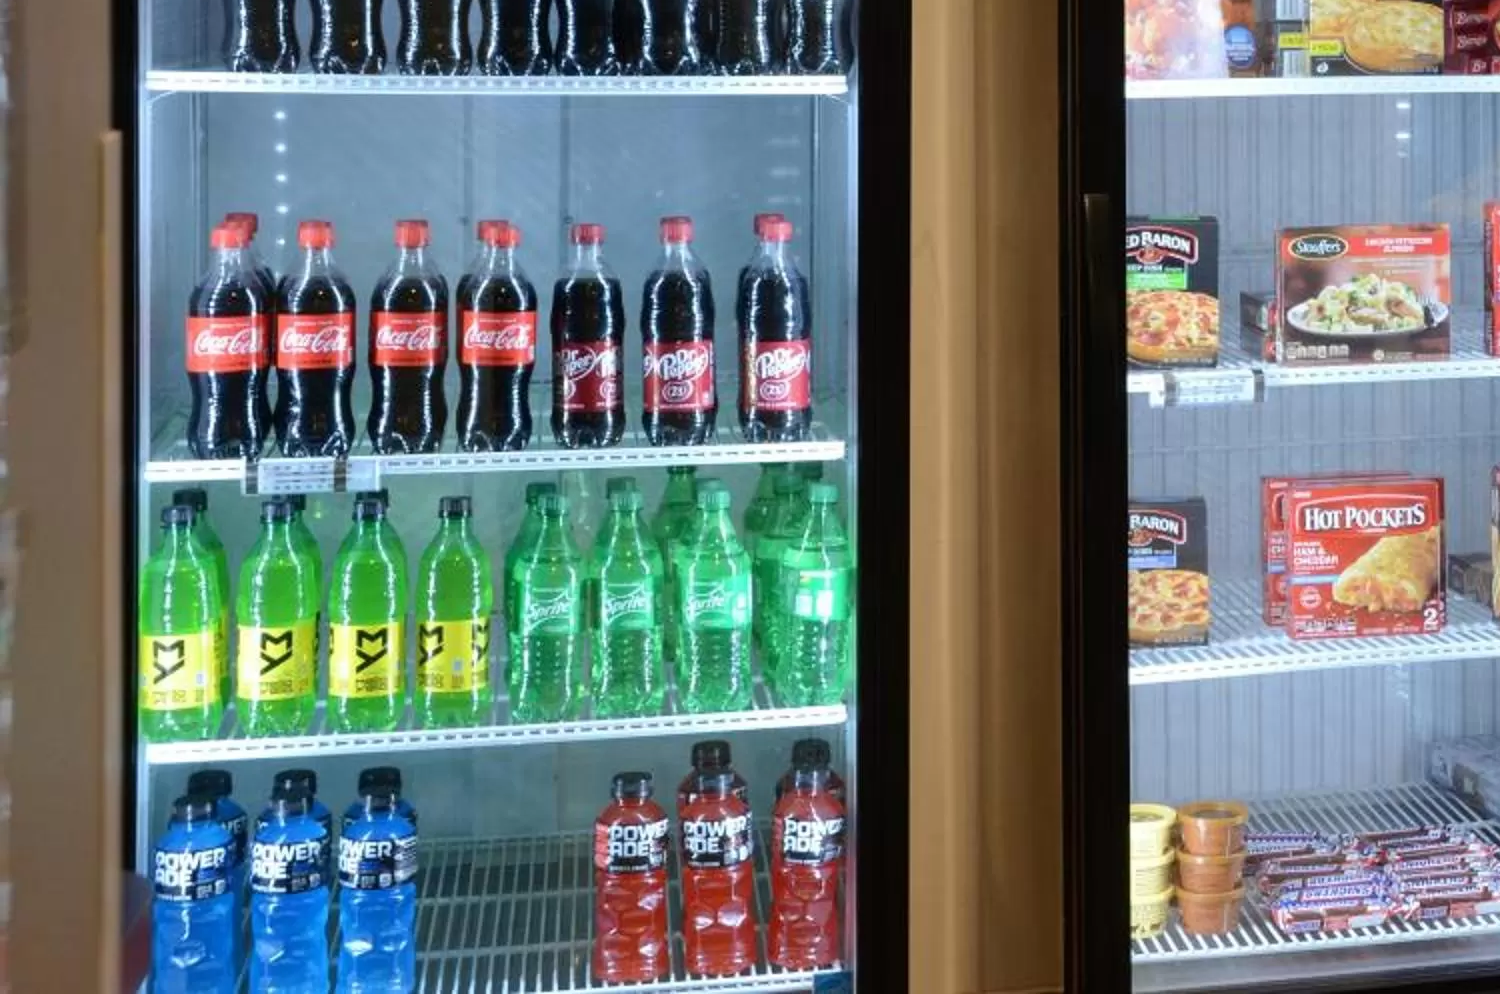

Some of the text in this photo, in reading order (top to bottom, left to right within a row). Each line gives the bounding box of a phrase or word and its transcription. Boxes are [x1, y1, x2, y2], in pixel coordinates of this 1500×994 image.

[1141, 231, 1191, 254] BARON
[193, 326, 263, 355] Coca-Cola
[279, 324, 350, 353] Coca-Cola
[376, 324, 442, 351] Coca-Cola
[463, 322, 532, 350] Coca-Cola
[1129, 513, 1179, 535] BARON
[1304, 503, 1425, 531] HOT POCKETS
[1423, 608, 1438, 625] 2
[155, 846, 227, 873] POWER
[609, 840, 649, 858] ADE
[155, 867, 193, 887] ADE
